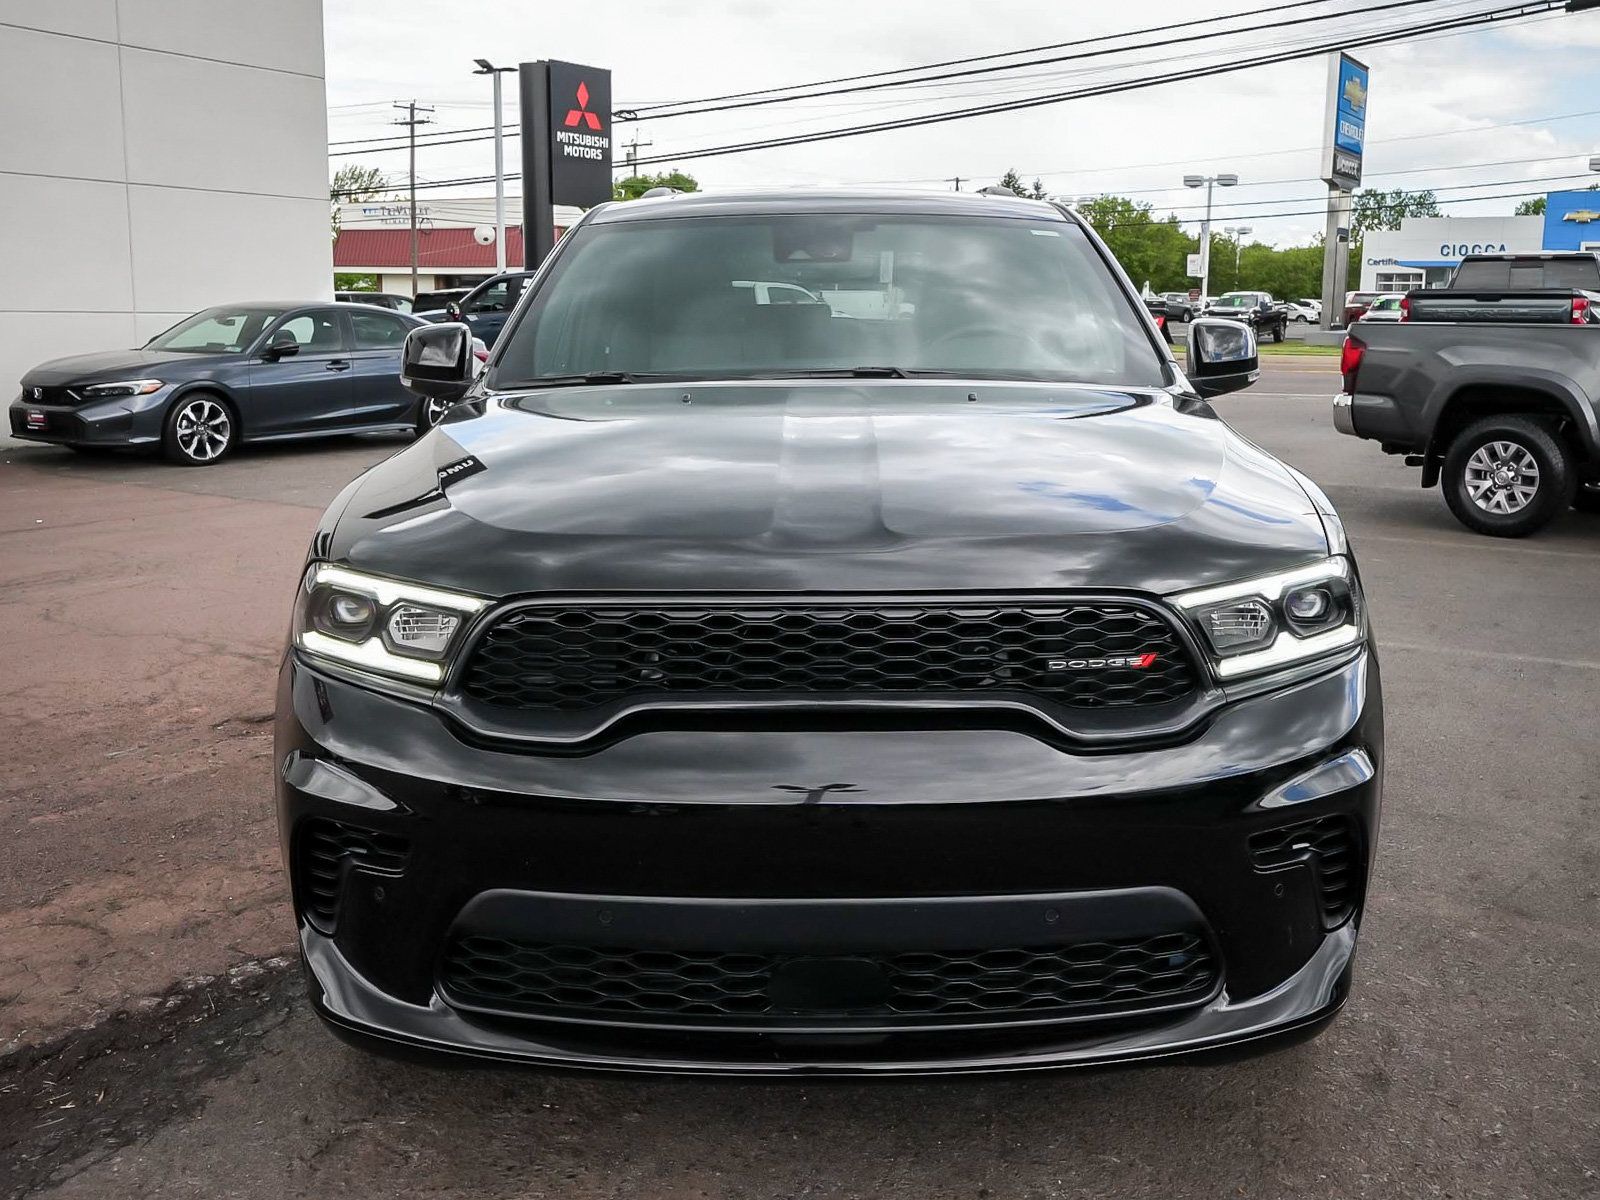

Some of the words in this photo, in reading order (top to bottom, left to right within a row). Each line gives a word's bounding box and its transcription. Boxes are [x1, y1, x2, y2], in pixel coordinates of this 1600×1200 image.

[556, 131, 609, 149] MITSUBISHI
[563, 145, 603, 160] MOTORS
[1440, 243, 1506, 257] CIOCCA
[1367, 257, 1400, 266] Certifie
[1048, 657, 1143, 669] DODGE
